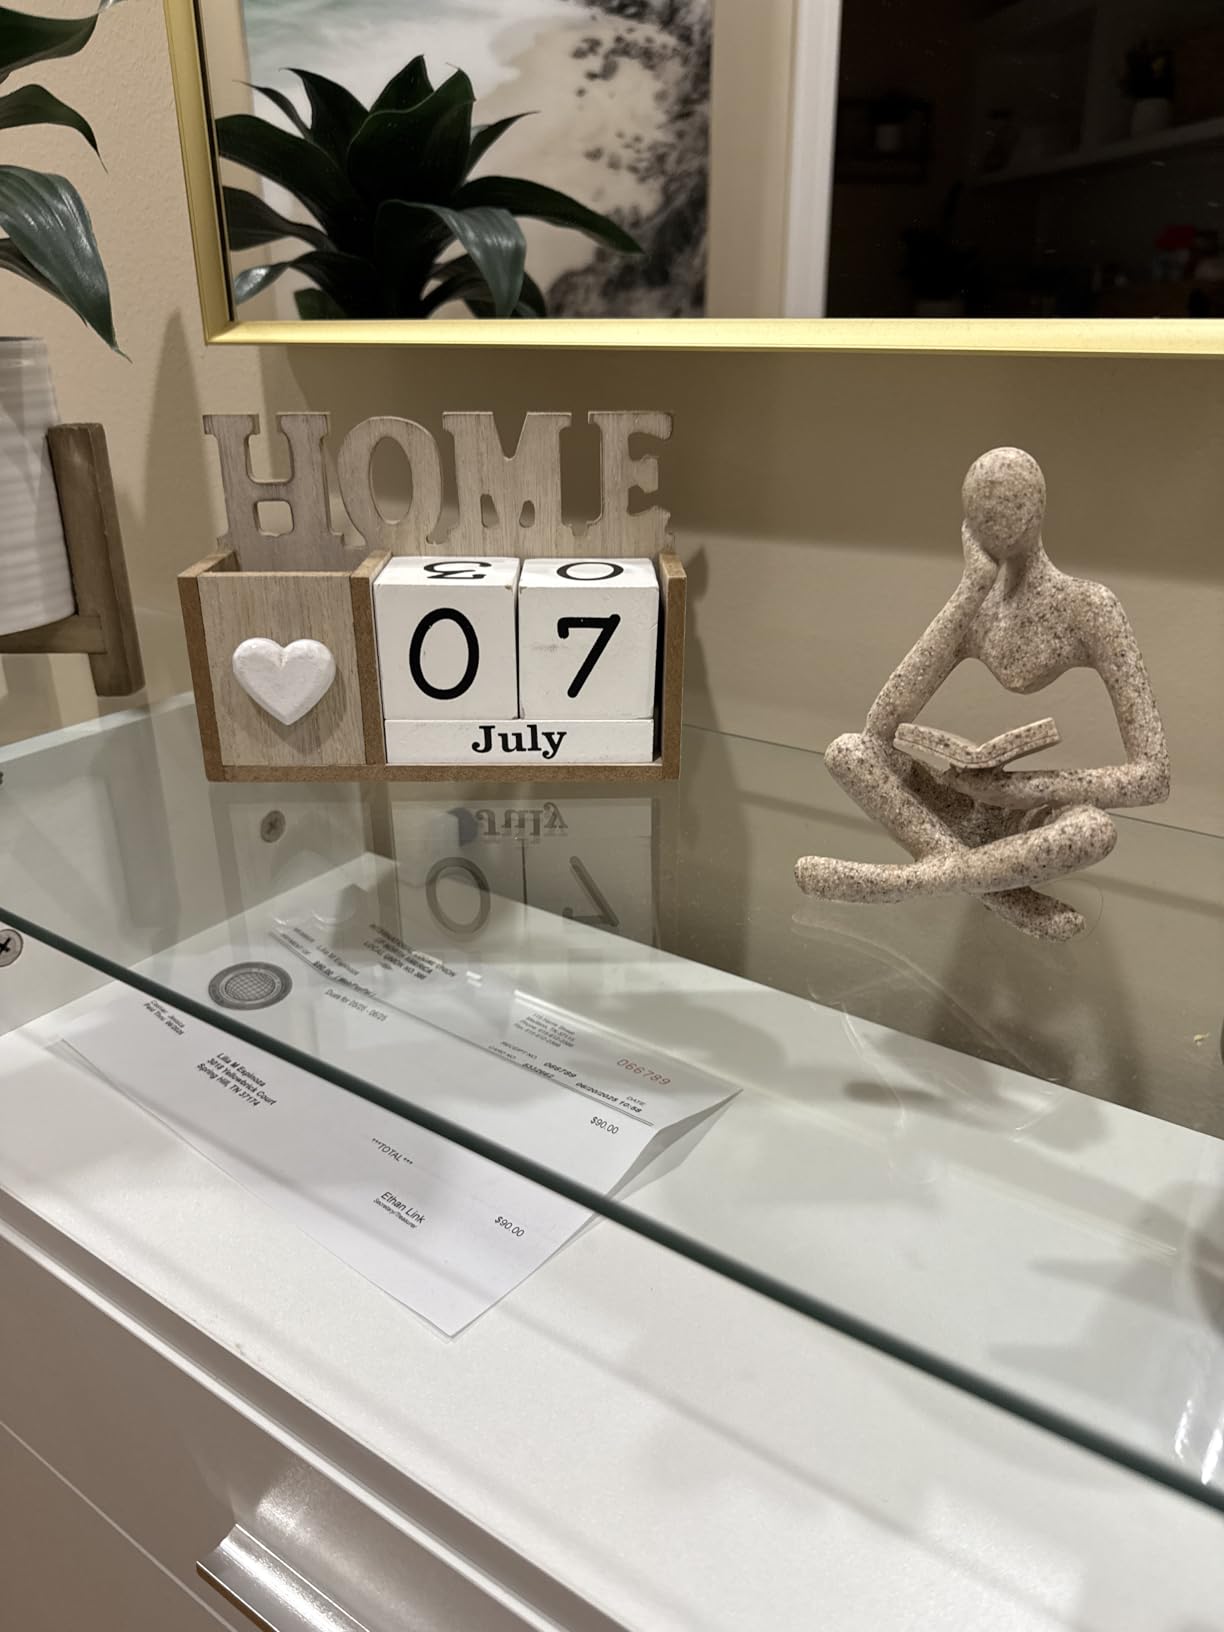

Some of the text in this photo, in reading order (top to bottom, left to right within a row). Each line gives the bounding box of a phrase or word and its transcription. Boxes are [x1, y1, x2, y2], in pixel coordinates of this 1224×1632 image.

[203, 411, 674, 546] HOME
[472, 724, 567, 760] July
[231, 1061, 240, 1069] M
[237, 1066, 266, 1087] Espinoza
[543, 1062, 577, 1078] 066789
[616, 1058, 672, 1086] 066789
[196, 1062, 217, 1080] Spring
[230, 1084, 241, 1094] TN
[238, 1091, 261, 1107] 37174
[222, 1067, 257, 1092] Yellowbrick
[255, 1090, 277, 1106] Court
[626, 1096, 647, 1107] DATE
[590, 1116, 619, 1135] $90.00
[380, 1191, 426, 1225] Ethan Link
[494, 1216, 525, 1237] $90.00
